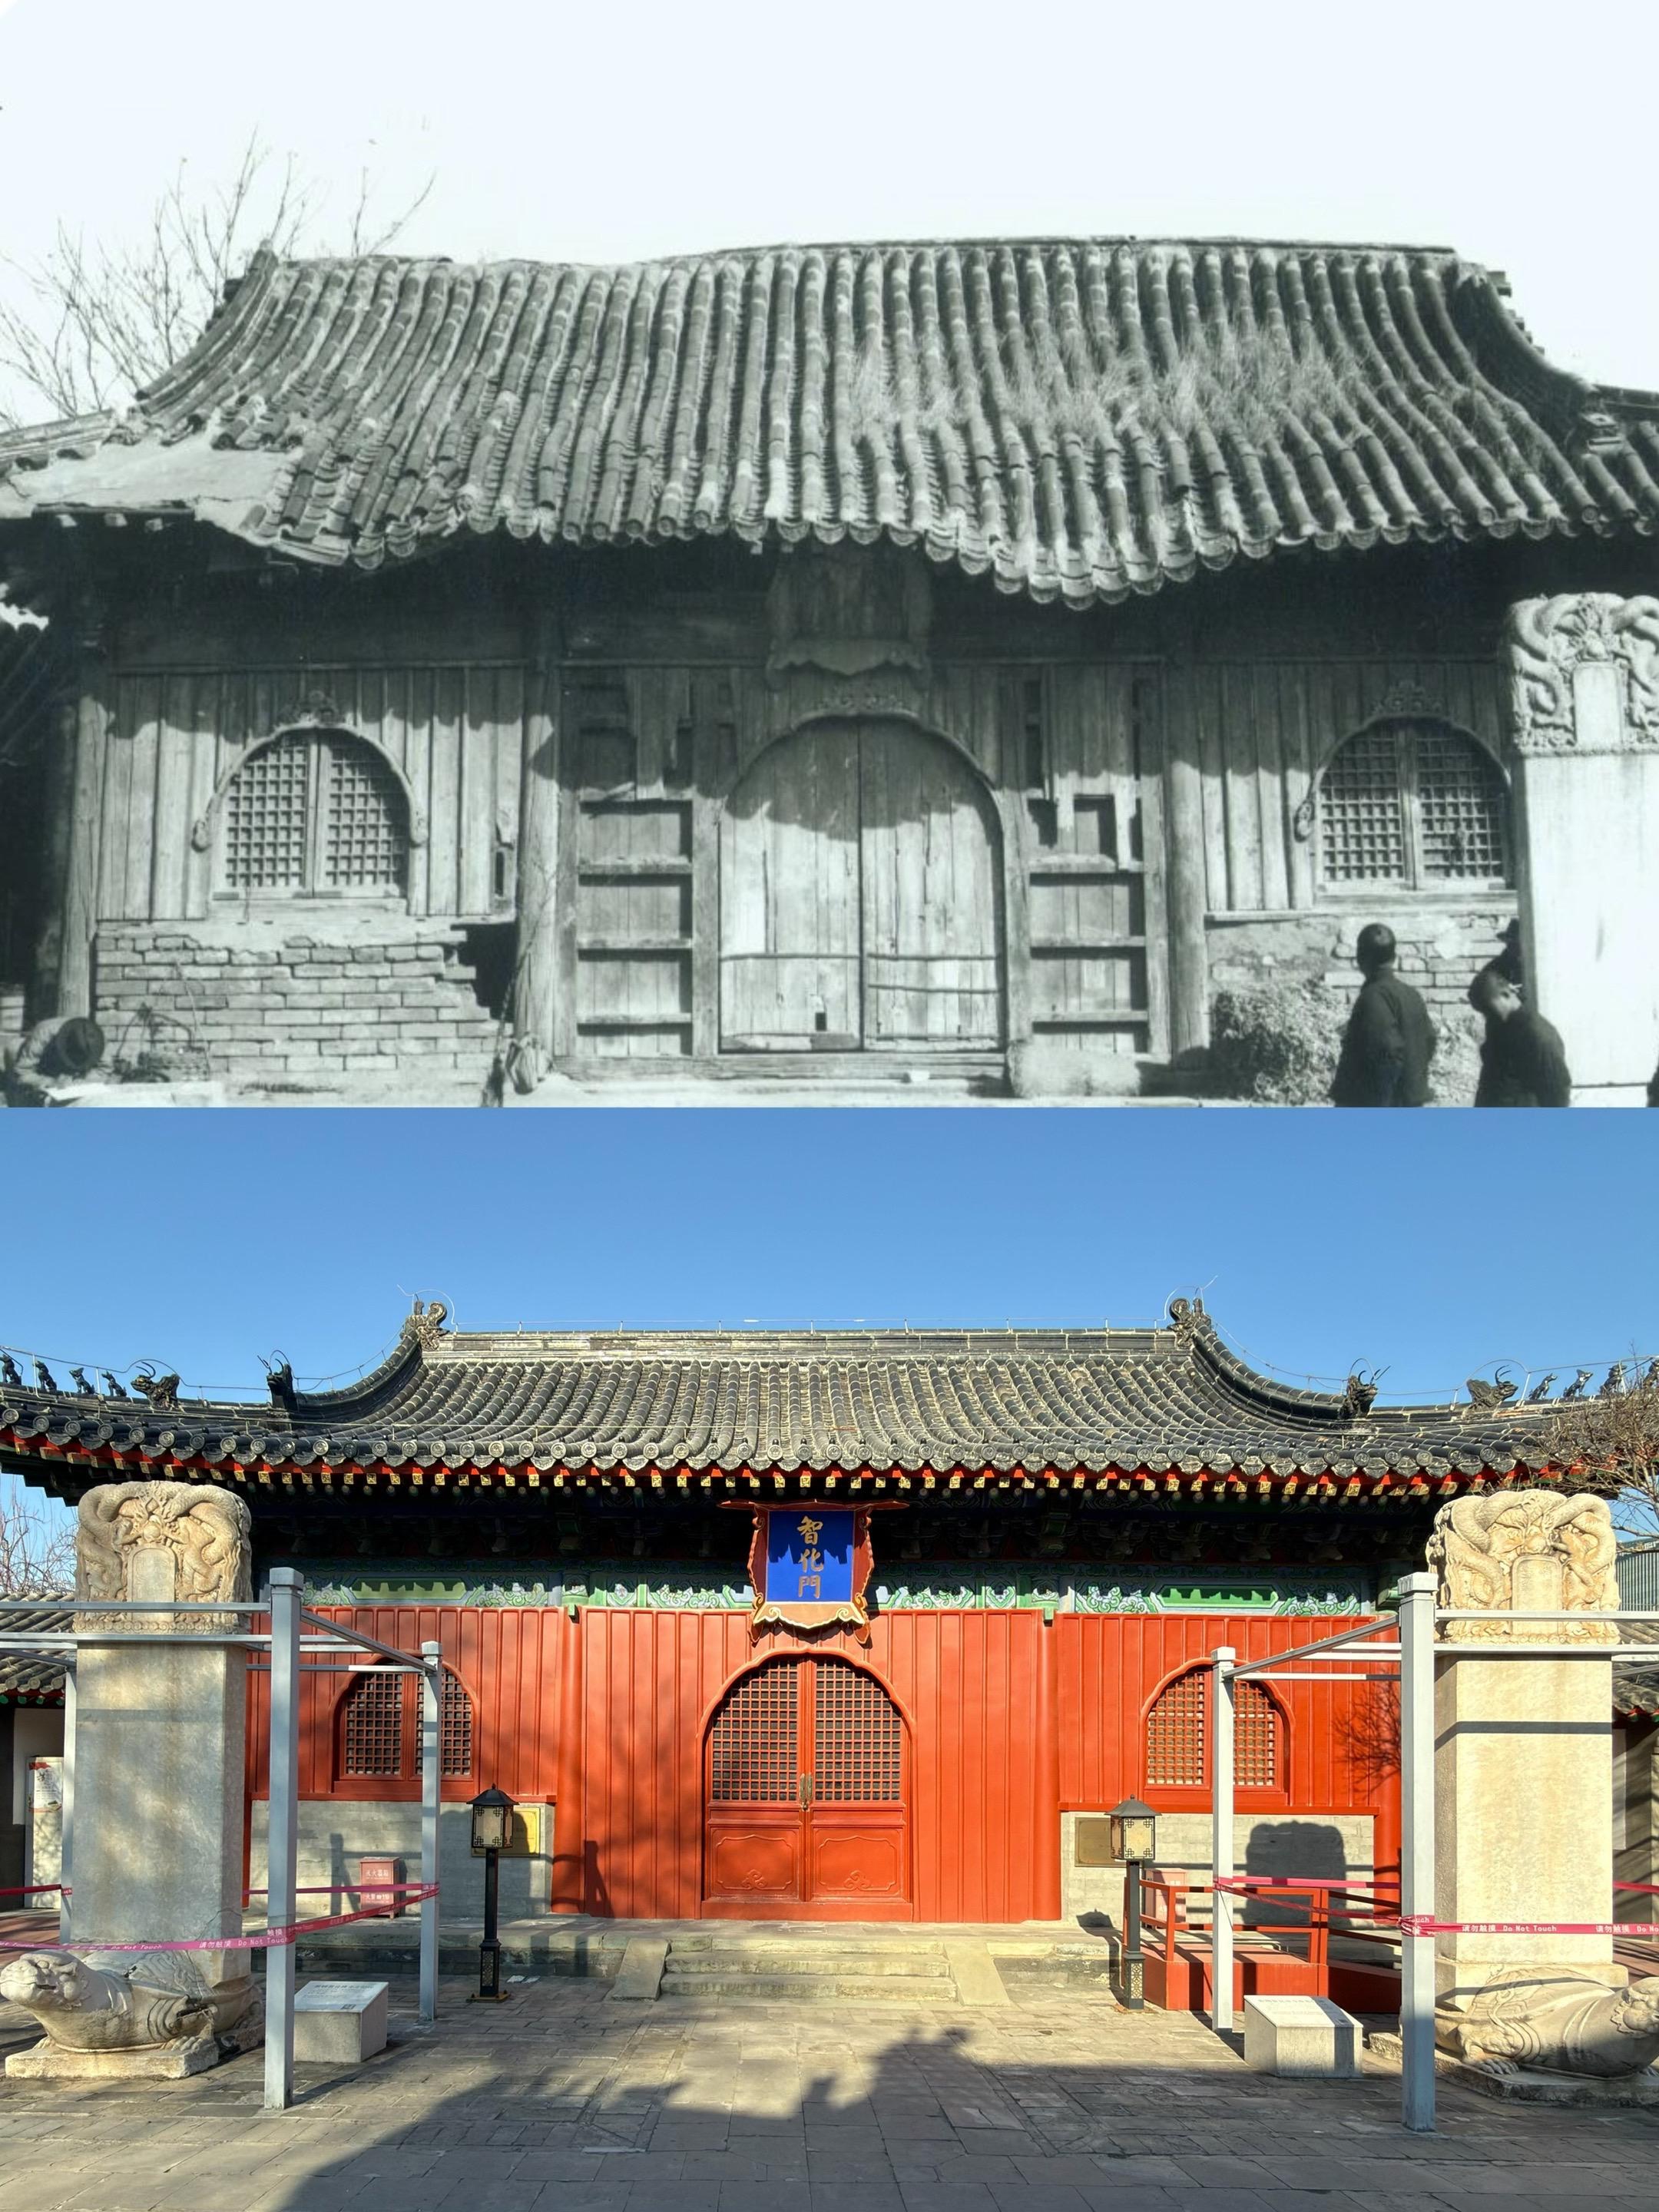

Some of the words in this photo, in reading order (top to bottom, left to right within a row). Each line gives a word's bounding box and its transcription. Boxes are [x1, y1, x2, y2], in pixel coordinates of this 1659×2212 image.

[796, 1515, 824, 1598] 智化門
[1462, 1924, 1497, 1932] 请勿触摸
[1595, 1925, 1631, 1933] 请勿触摸
[198, 1940, 231, 1949] 请勿触摸
[250, 1937, 264, 1945] Not
